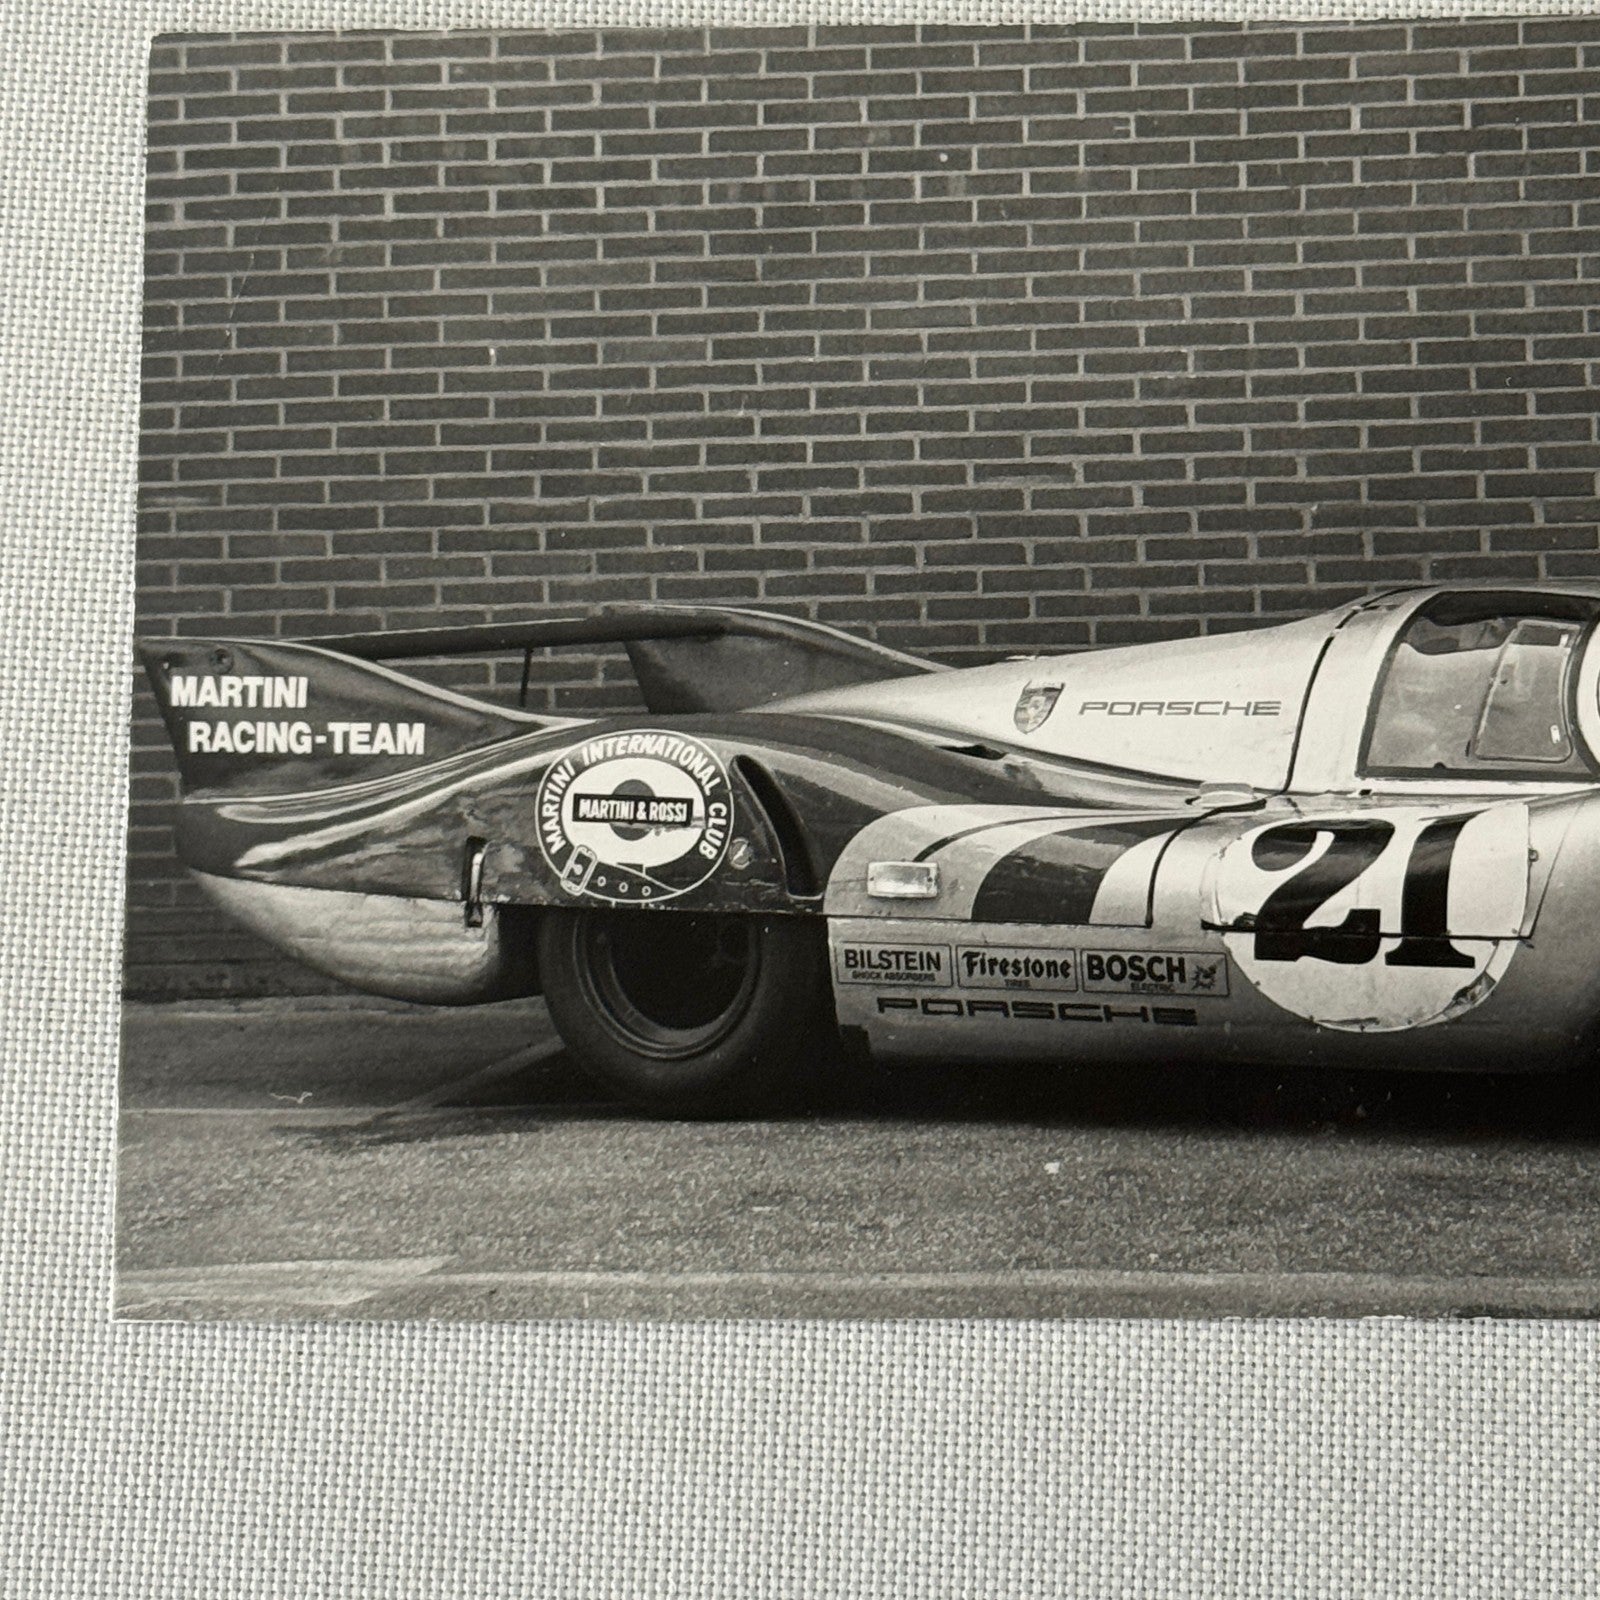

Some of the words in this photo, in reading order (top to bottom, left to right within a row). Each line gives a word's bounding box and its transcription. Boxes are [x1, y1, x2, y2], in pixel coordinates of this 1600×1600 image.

[171, 676, 308, 708] MARTINI
[1079, 701, 1282, 716] PORSCHE
[189, 721, 426, 755] RACING-TEAM
[541, 758, 576, 855] MARTINI
[581, 734, 721, 796] INTERNATIONAL
[699, 802, 728, 860] CLUB
[578, 798, 635, 820] MARTINI
[636, 801, 648, 820] &
[649, 801, 688, 822] ROSSI
[1251, 812, 1482, 969] 21
[844, 949, 941, 971] BILSTEIN
[962, 951, 1071, 978] Firestone
[1086, 953, 1186, 983] BOSCH
[877, 997, 1198, 1027] PORSCHE
